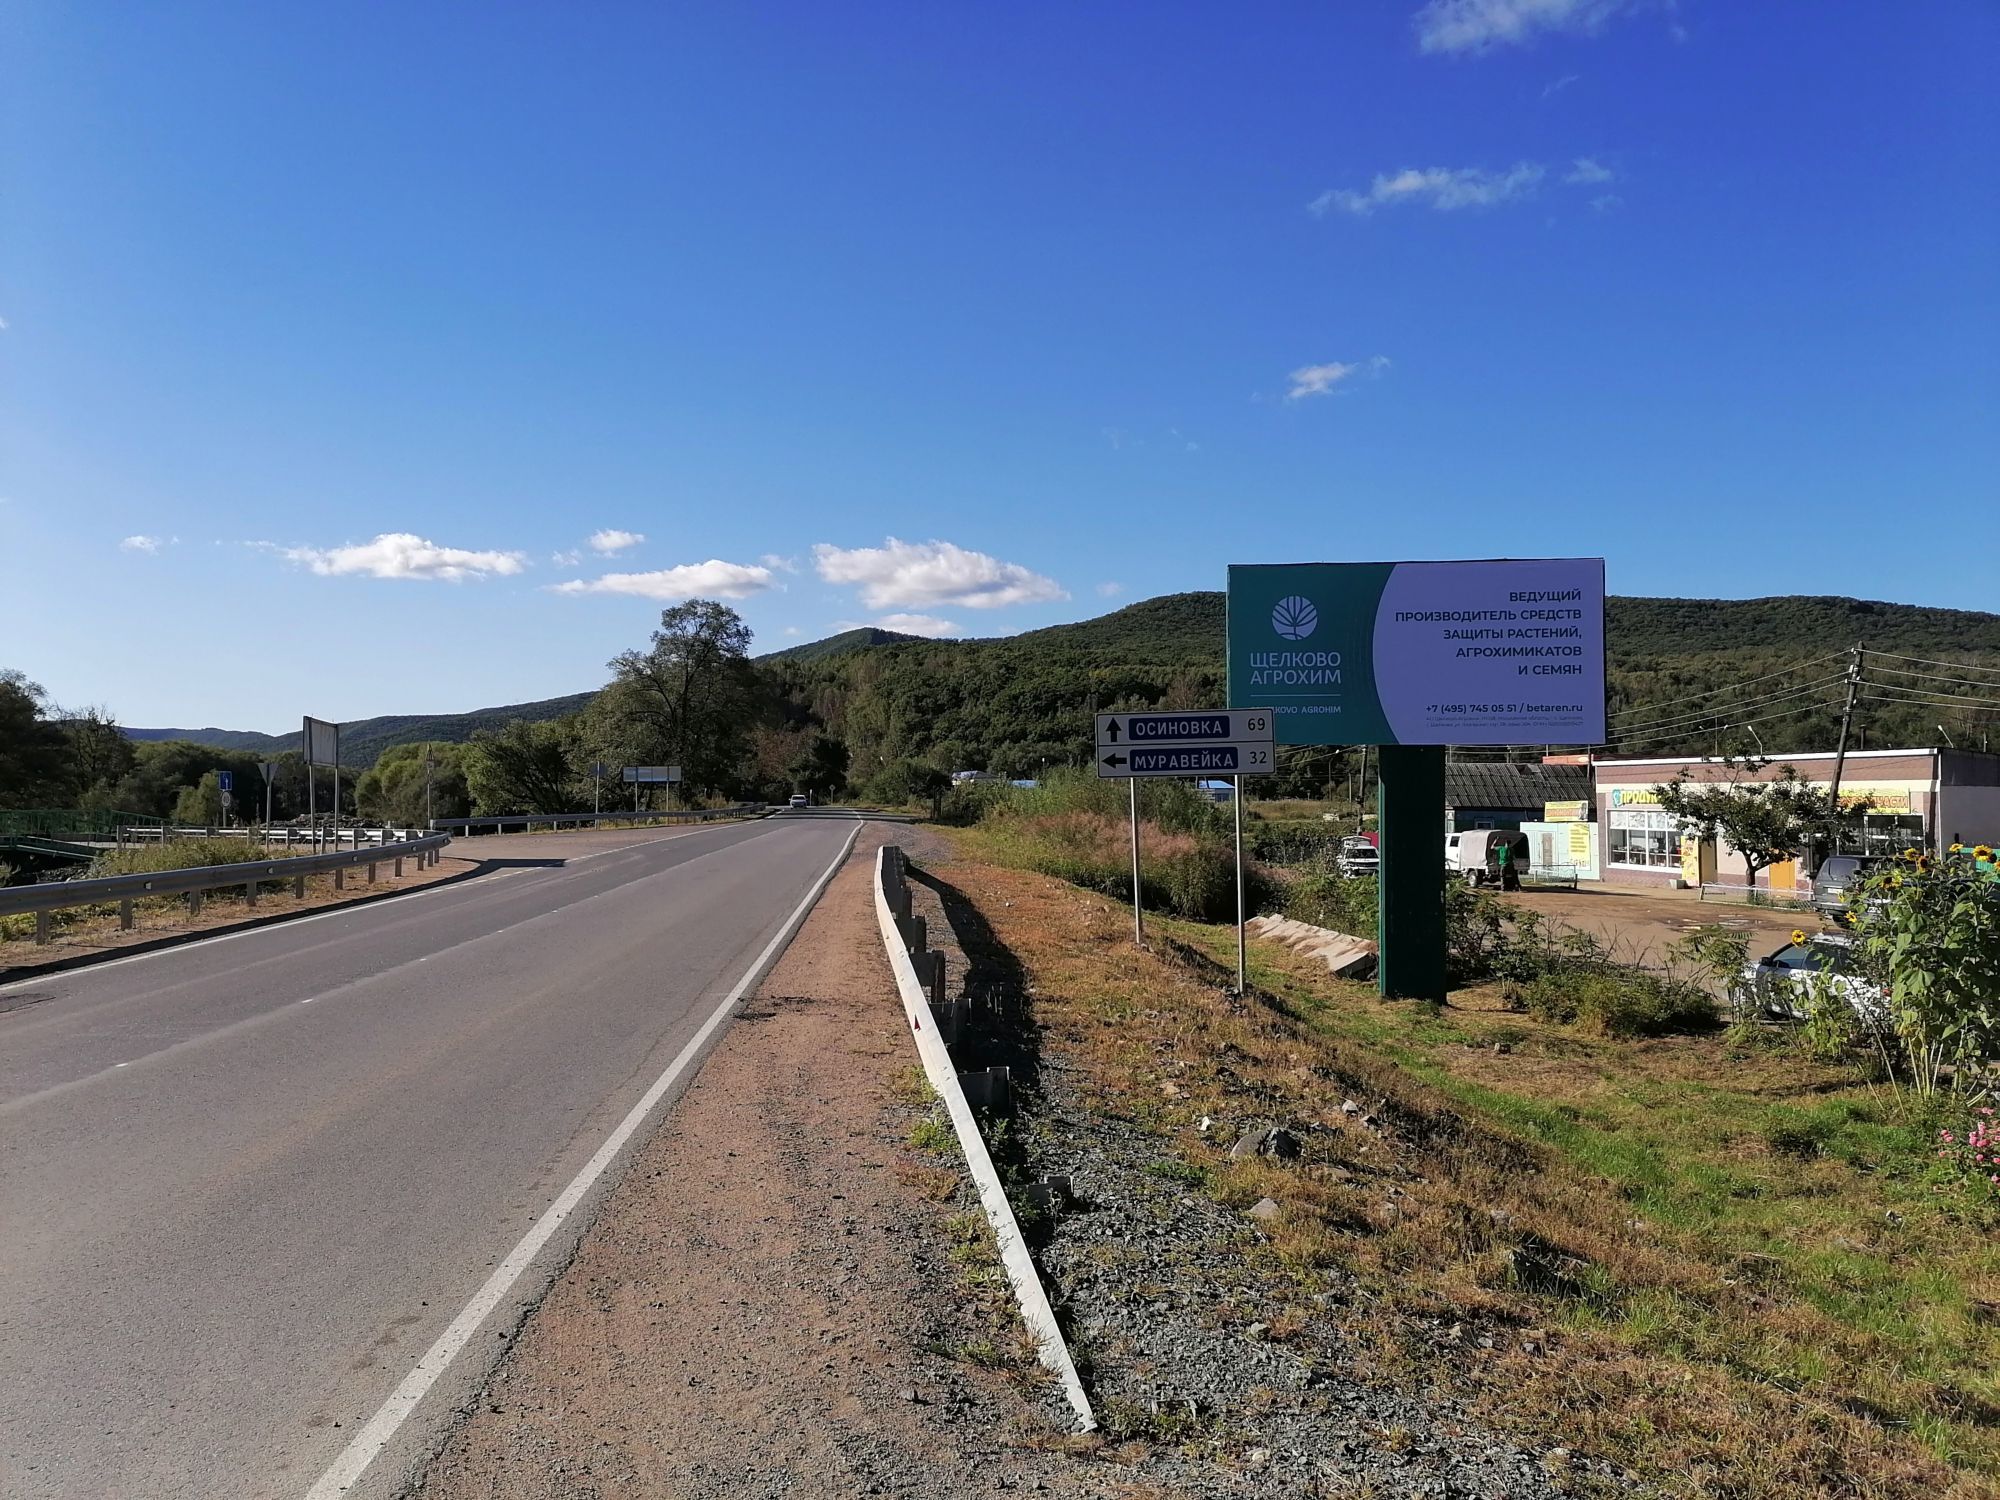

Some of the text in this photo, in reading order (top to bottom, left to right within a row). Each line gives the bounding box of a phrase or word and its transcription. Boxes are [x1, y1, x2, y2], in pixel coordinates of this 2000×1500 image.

[1509, 588, 1581, 603] ВЕДУЩИЙ
[1395, 609, 1582, 623] ПРОИЗВОДИТЕЛЬ СРЕДСТВ
[1443, 625, 1582, 641] ЗАЩИТЫ РАСТЕНИЙ,
[1455, 646, 1582, 658] АГРОХИМИКАТОВ
[1250, 652, 1341, 668] ЩЕЛКОВО
[1250, 669, 1342, 685] АГРОХИМ
[1518, 664, 1582, 675] И СЕМЯН
[1301, 706, 1341, 714] AGROHIM
[1426, 704, 1438, 713] +7
[1441, 704, 1467, 714] (495)
[1470, 704, 1488, 713] 745
[1491, 704, 1504, 713] 05
[1506, 704, 1517, 713] 51
[1526, 703, 1583, 713] betaren.ru
[1135, 717, 1265, 736] ОСИНОВКА 69
[1134, 750, 1267, 769] МУРАВЕЙКА 32
